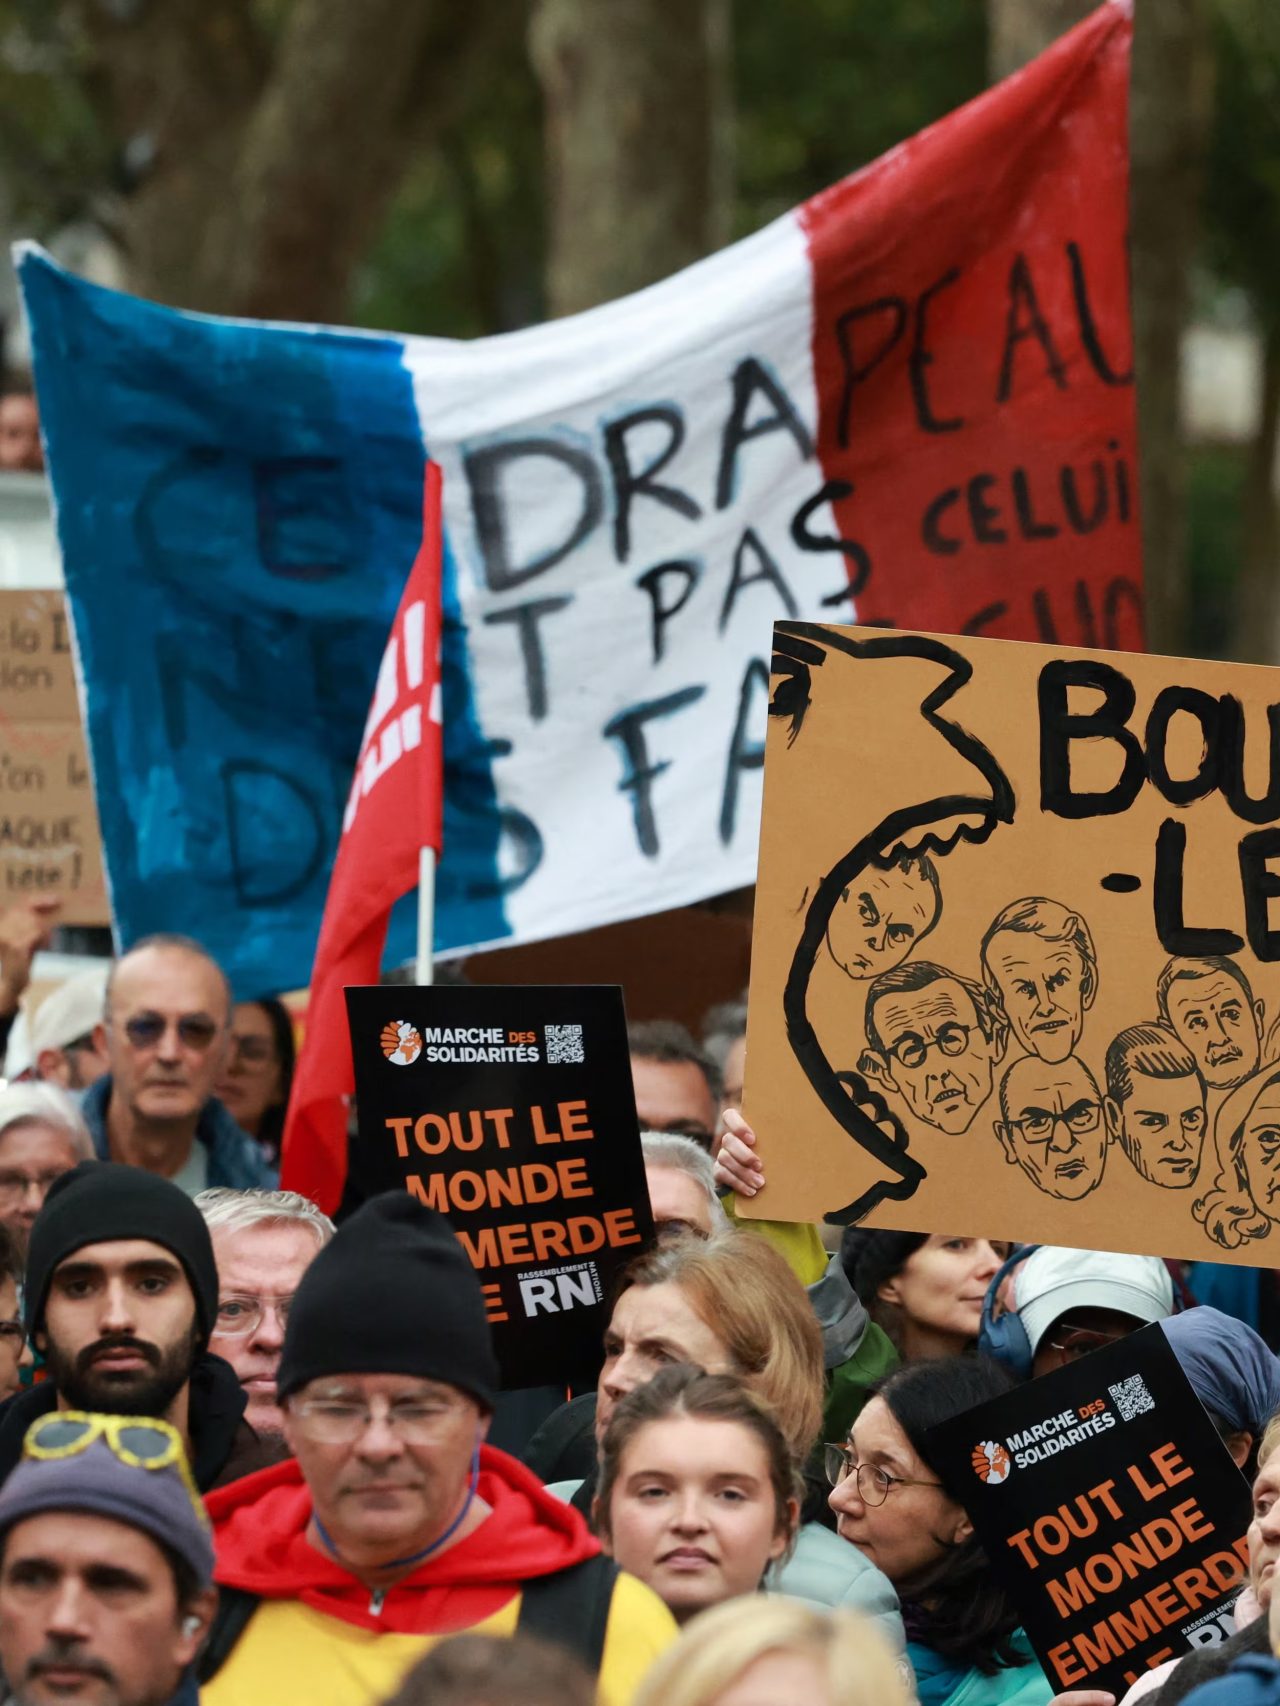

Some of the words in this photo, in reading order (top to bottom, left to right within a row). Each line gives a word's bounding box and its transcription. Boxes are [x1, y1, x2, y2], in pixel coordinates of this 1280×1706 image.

[463, 243, 1133, 592] DRAPEAU
[636, 480, 871, 665] PAS
[425, 1027, 505, 1044] MARCHE
[509, 1031, 536, 1043] DES
[426, 1043, 540, 1063] SOLIDARITÉS
[385, 1108, 514, 1158] TOUT
[530, 1100, 594, 1145] LE
[406, 1157, 594, 1214] MONDE
[453, 1207, 642, 1270] MERDE
[517, 1262, 588, 1280] RASSEMBLEMENT
[519, 1271, 600, 1318] RN
[588, 1261, 604, 1303] NATIONAL
[480, 1283, 508, 1324] E
[1005, 1409, 1079, 1453] MARCHE
[1078, 1398, 1106, 1420] DES
[1014, 1411, 1116, 1470] SOLIDARITÉS
[1006, 1478, 1125, 1570] TOUT
[1126, 1441, 1195, 1502] LE
[1045, 1497, 1216, 1620] MONDE
[1181, 1597, 1240, 1636] RASSEMBLEMEN
